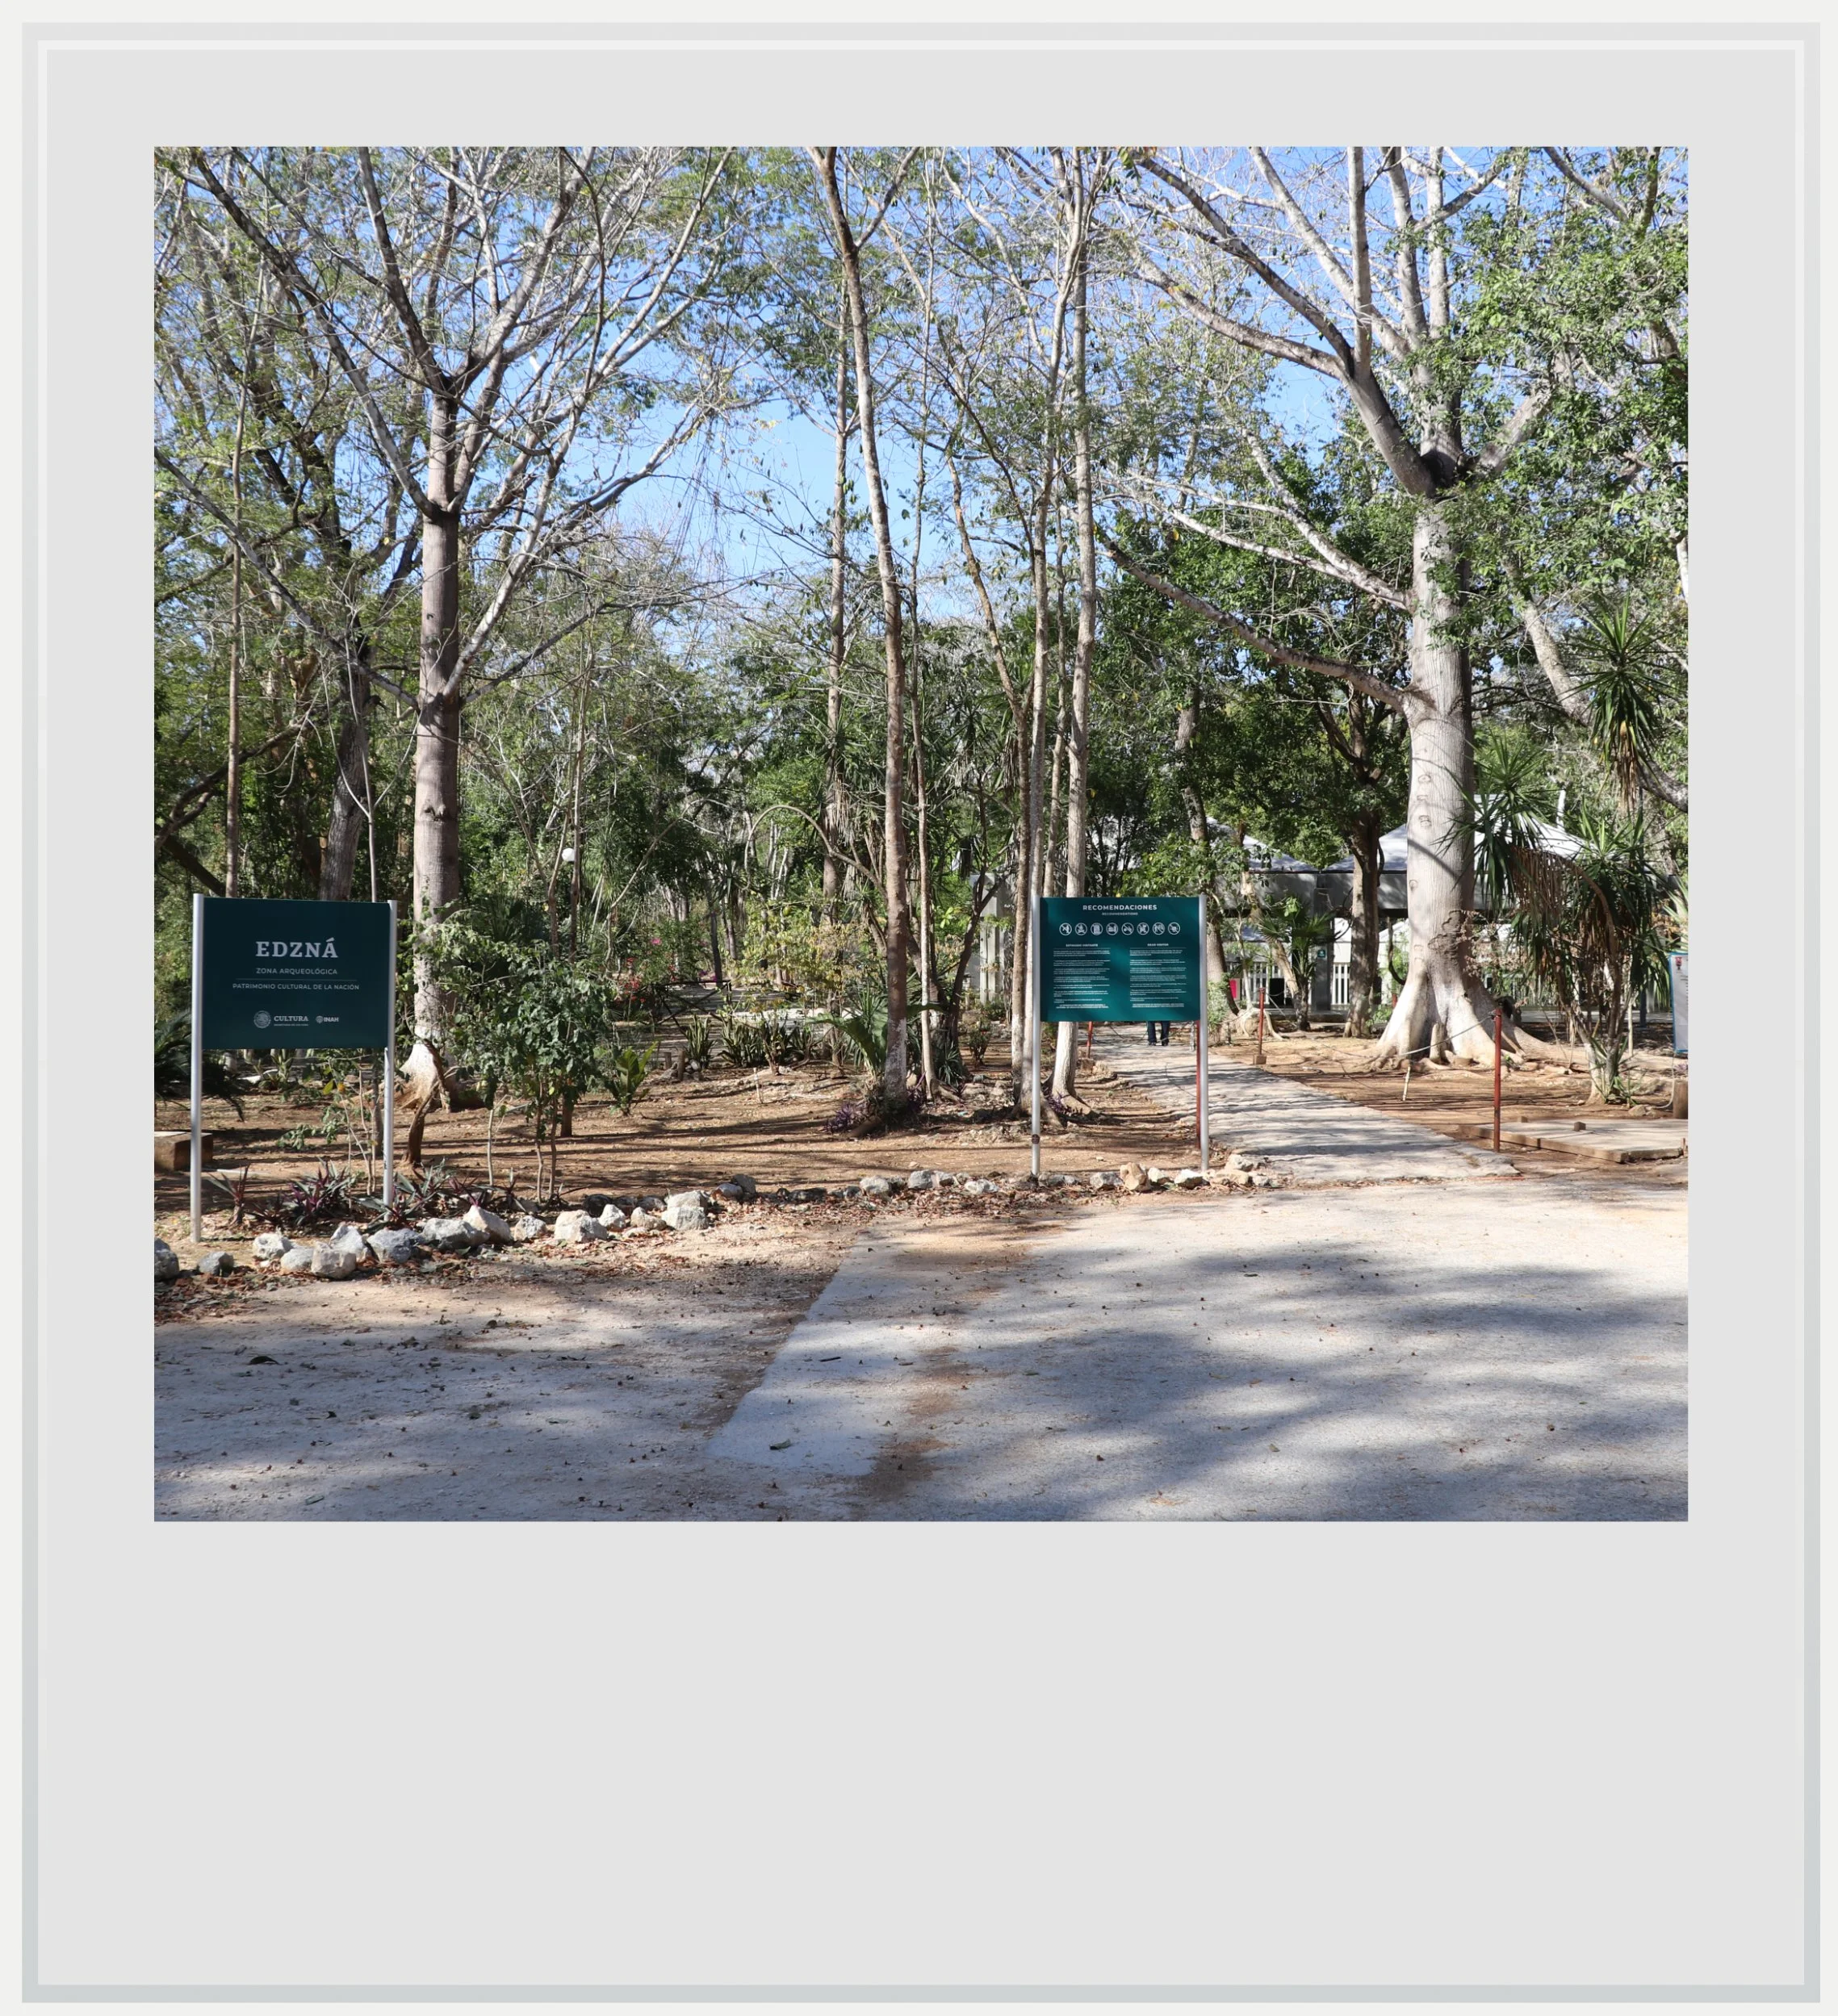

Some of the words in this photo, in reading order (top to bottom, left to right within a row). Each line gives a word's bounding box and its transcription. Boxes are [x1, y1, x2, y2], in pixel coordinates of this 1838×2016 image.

[255, 937, 339, 958] EDZNÁ
[279, 968, 337, 976] ARQUEOLÓGICA
[334, 983, 360, 991] NACIÓN
